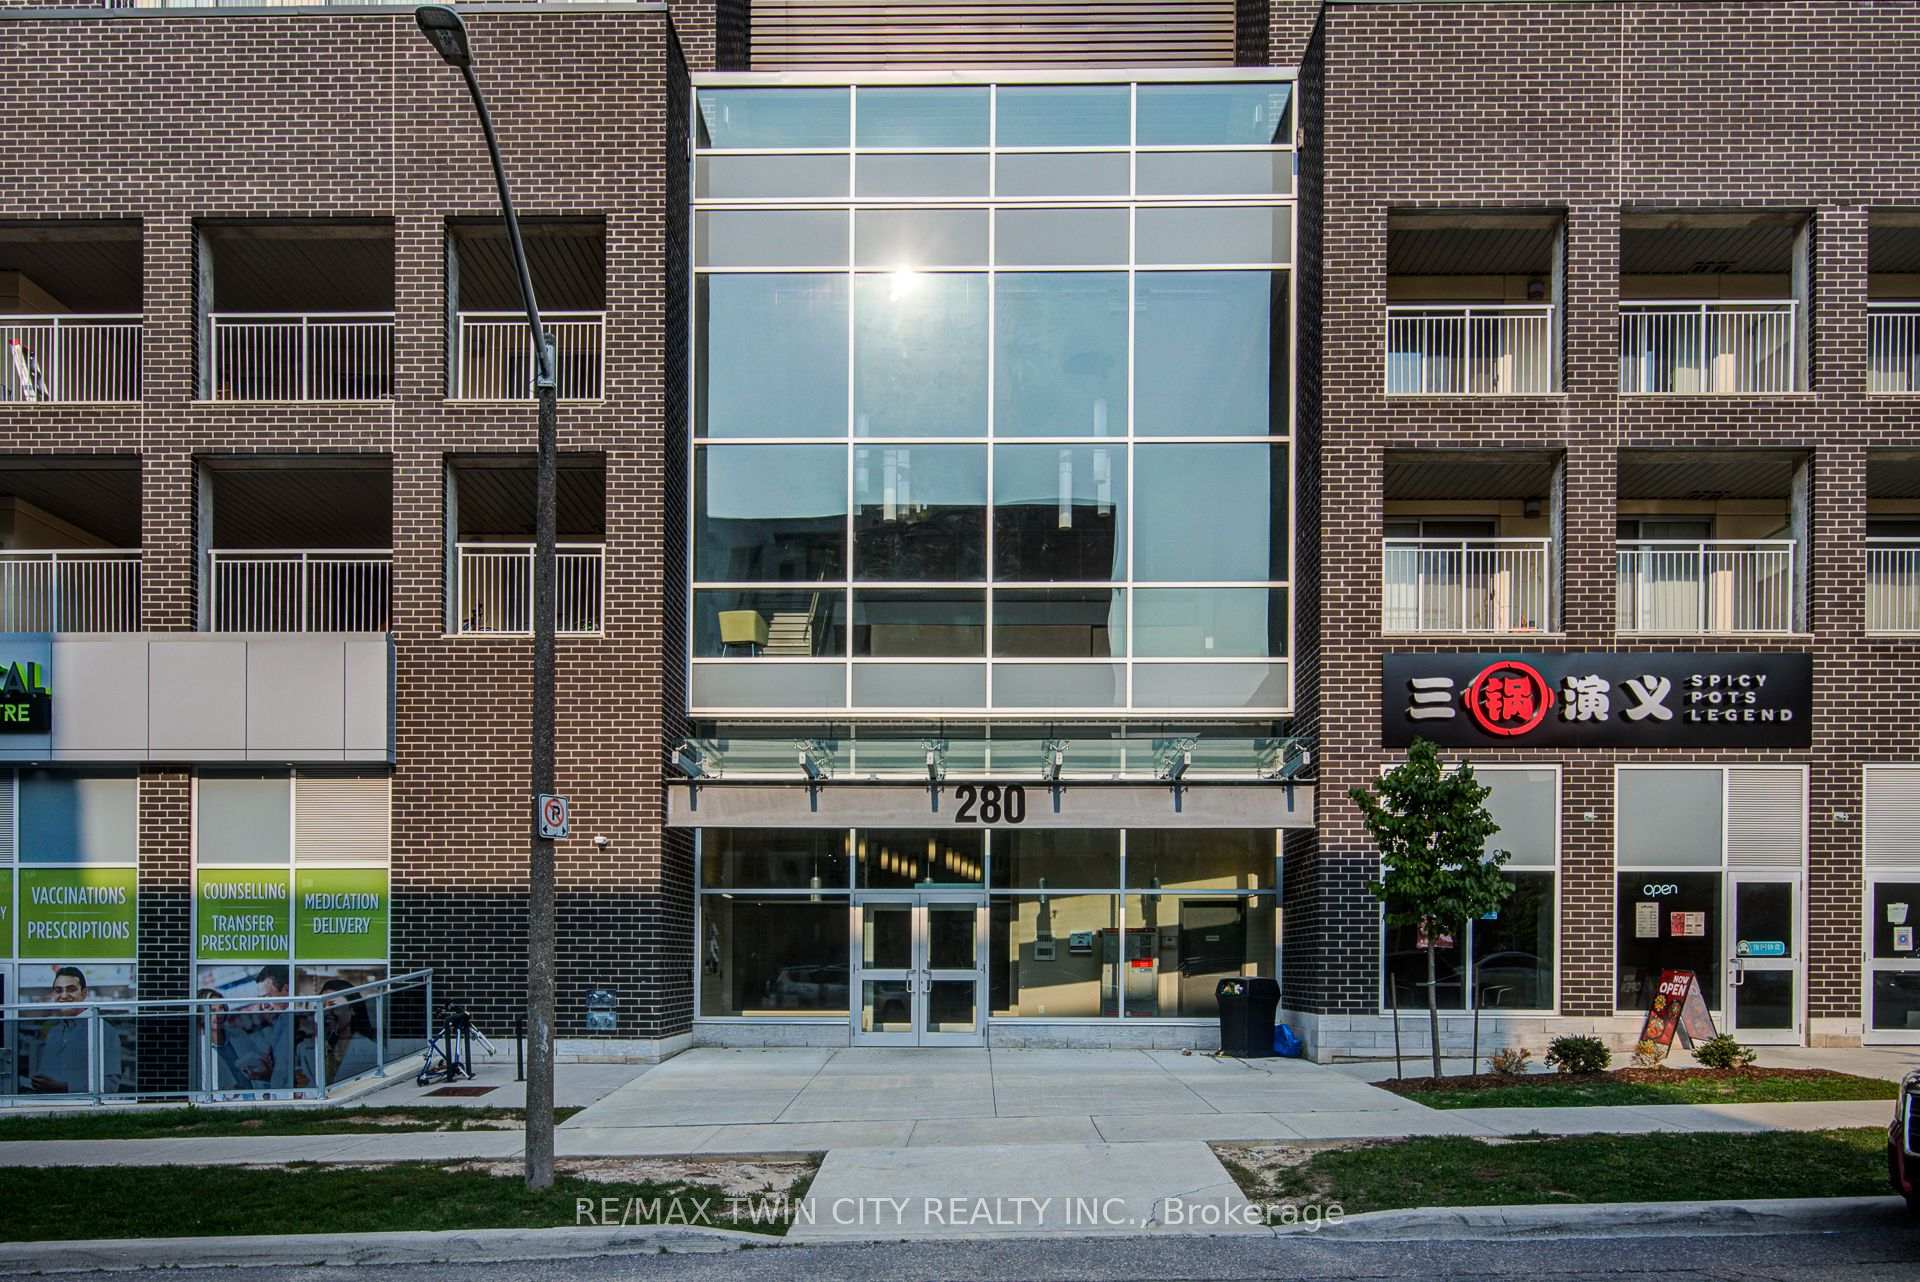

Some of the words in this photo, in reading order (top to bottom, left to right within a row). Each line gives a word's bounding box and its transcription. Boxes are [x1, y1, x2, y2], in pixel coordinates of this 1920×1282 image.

[1691, 674, 1767, 687] SPICY
[1406, 674, 1673, 722] 三锅演义
[1691, 691, 1757, 704] POTS
[1691, 708, 1793, 721] LEGEND
[955, 784, 1026, 824] 280
[31, 886, 127, 905] VACCINATIONS
[203, 882, 286, 900] COUNSELLING
[1643, 884, 1678, 898] open
[304, 892, 379, 910] MEDICATION
[27, 920, 130, 939] PRESCRIPTIONS
[211, 914, 275, 932] TRANSFER
[312, 916, 372, 934] DELIVERY
[201, 934, 288, 951] PRESCRIPTION
[1672, 975, 1690, 985] NOW
[1659, 982, 1687, 997] OPEN
